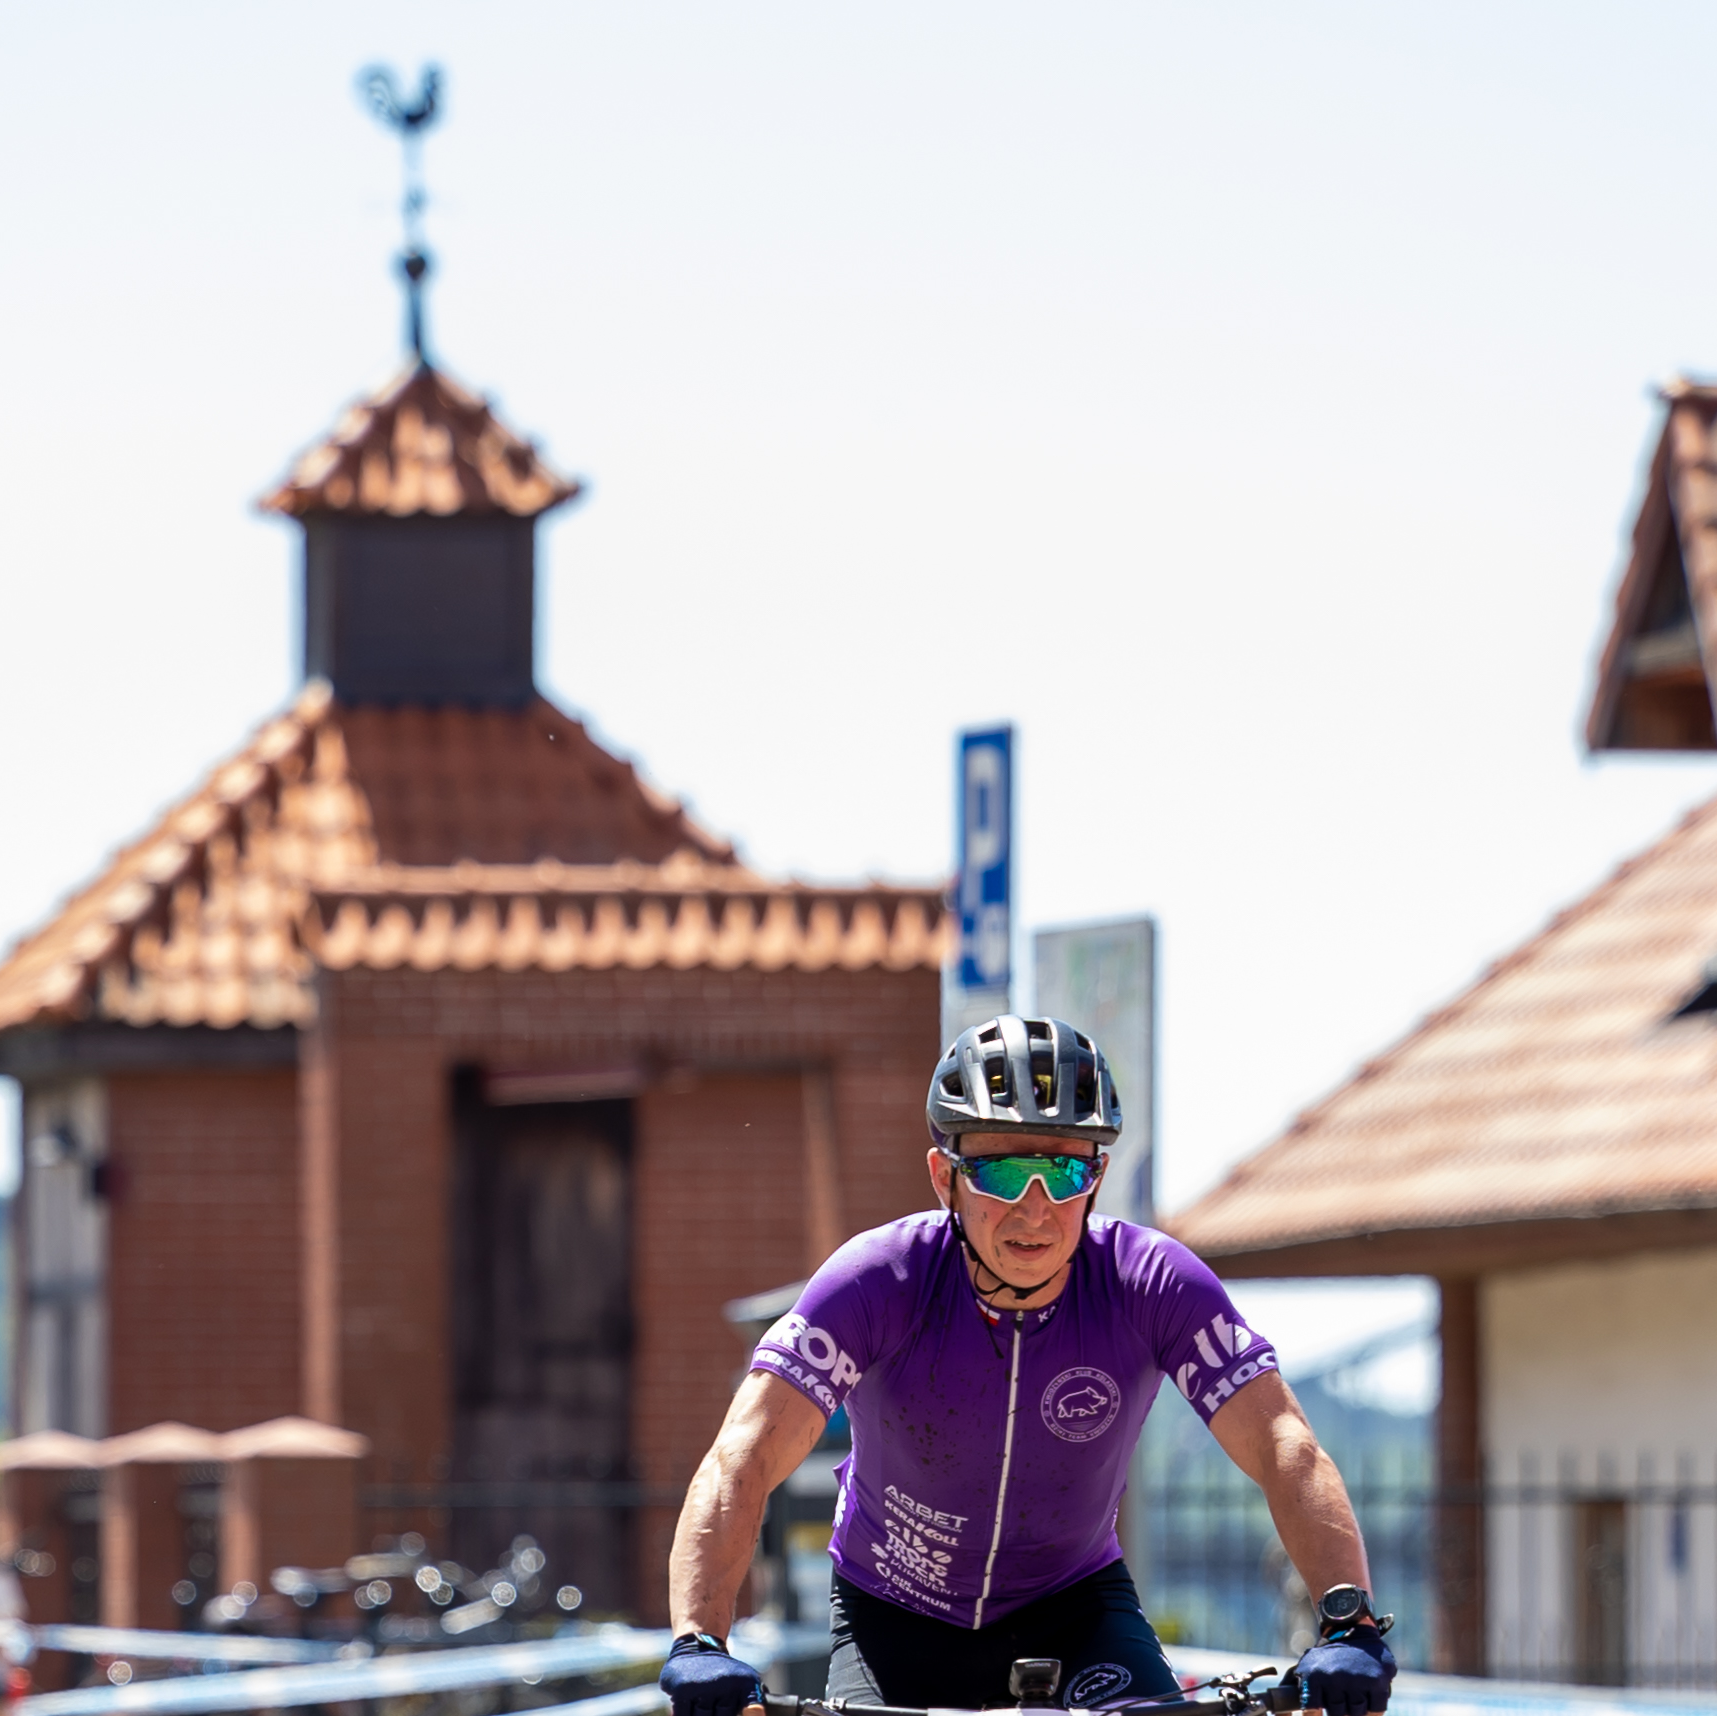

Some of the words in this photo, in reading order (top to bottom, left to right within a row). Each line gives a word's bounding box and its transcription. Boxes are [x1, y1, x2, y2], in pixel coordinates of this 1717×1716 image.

[884, 1485, 969, 1528] ARBET
[884, 1500, 960, 1546] KERAKOLL
[892, 1577, 951, 1611] CENTRUM
